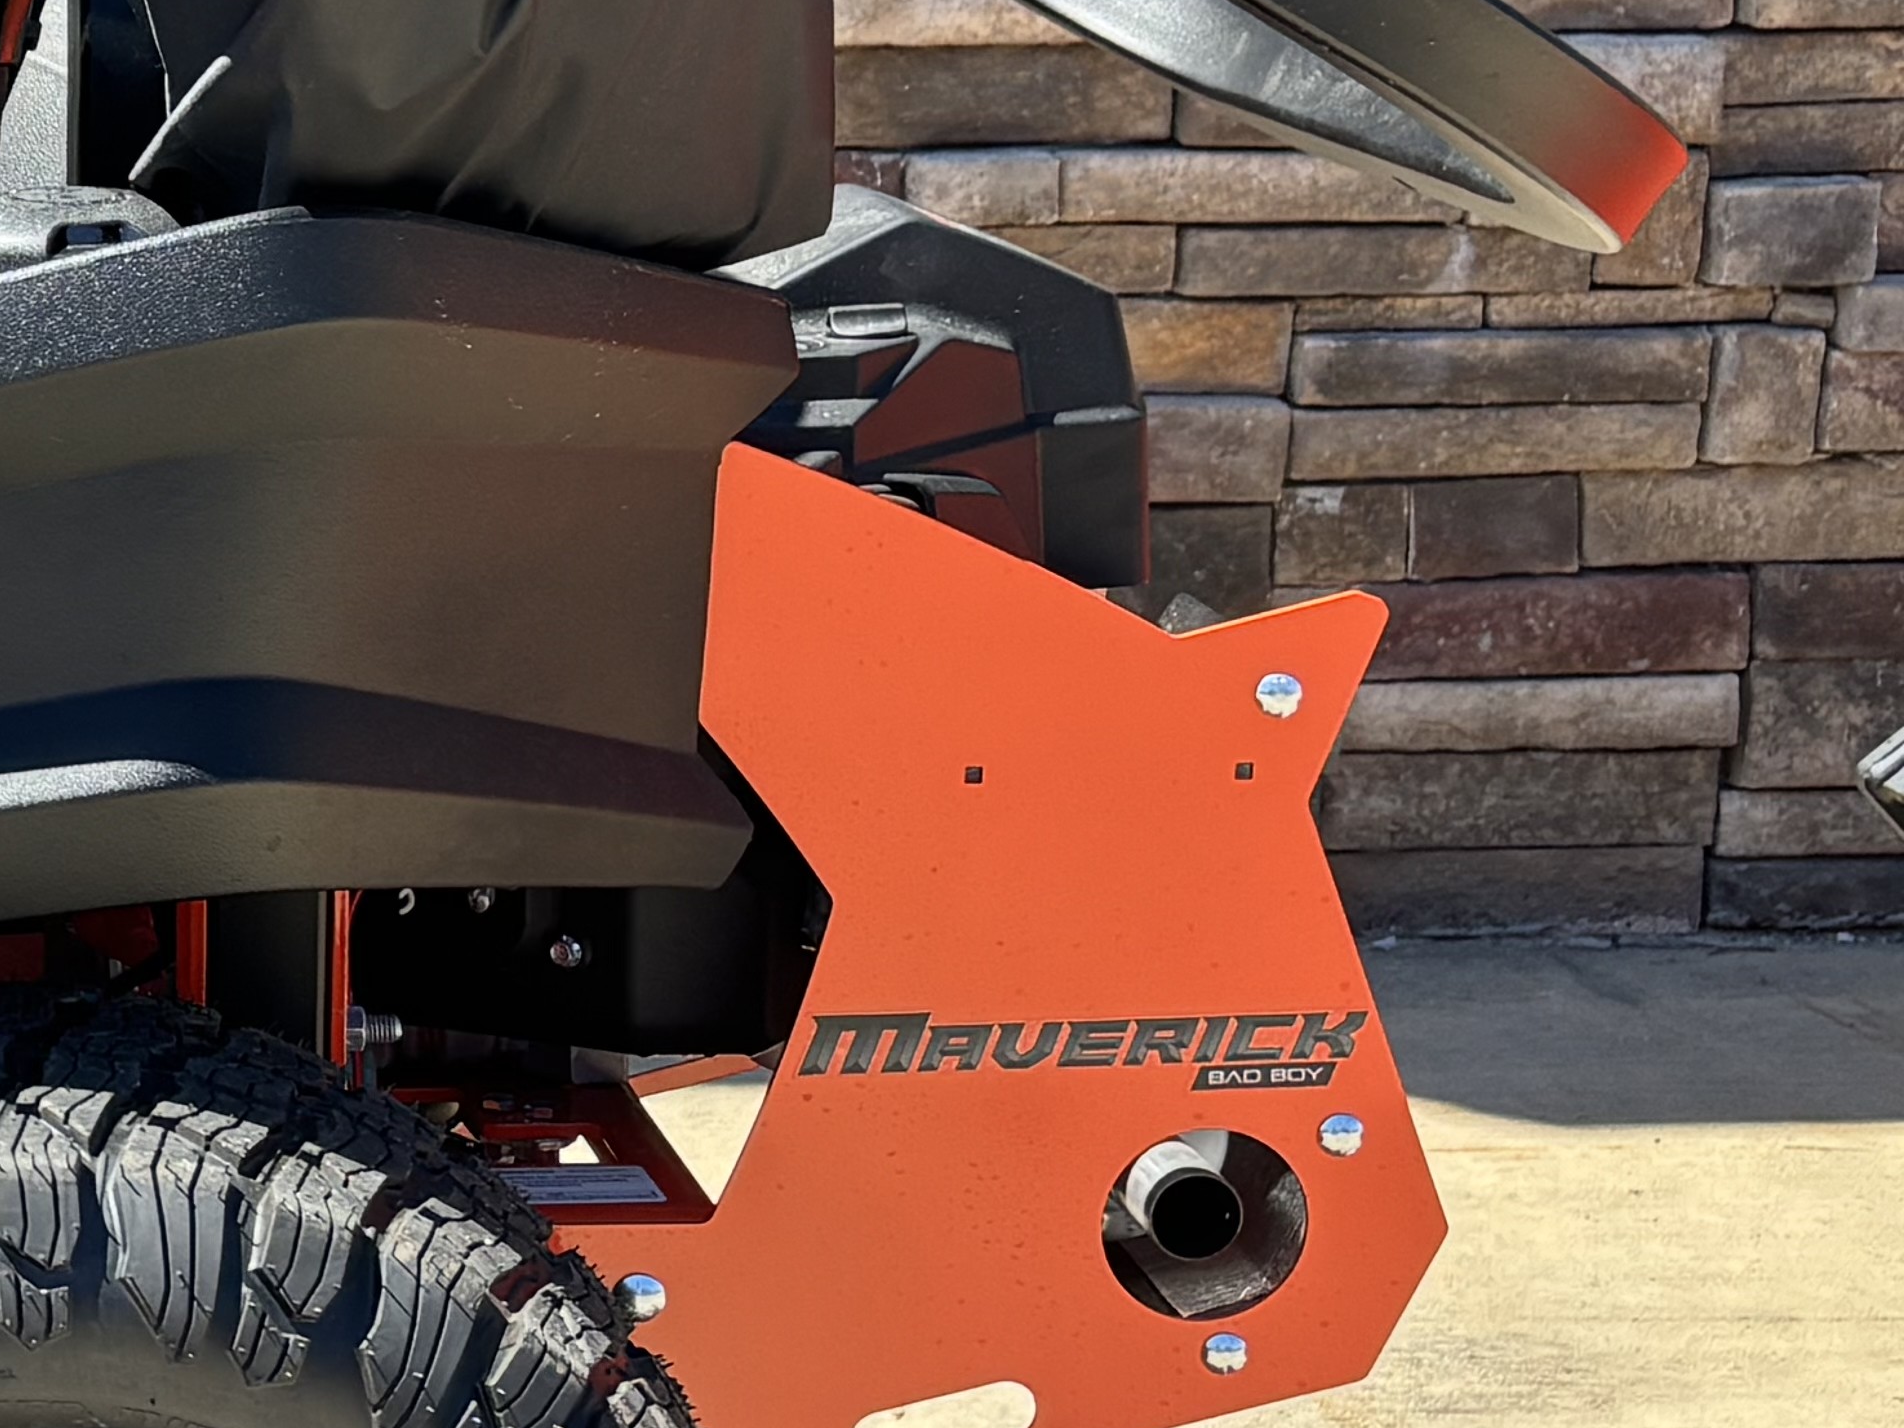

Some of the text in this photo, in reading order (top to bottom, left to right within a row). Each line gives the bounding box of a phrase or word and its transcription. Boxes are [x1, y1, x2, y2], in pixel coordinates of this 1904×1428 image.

[797, 1010, 1370, 1077] MAVERICK
[1206, 1065, 1326, 1086] BAD BOY
